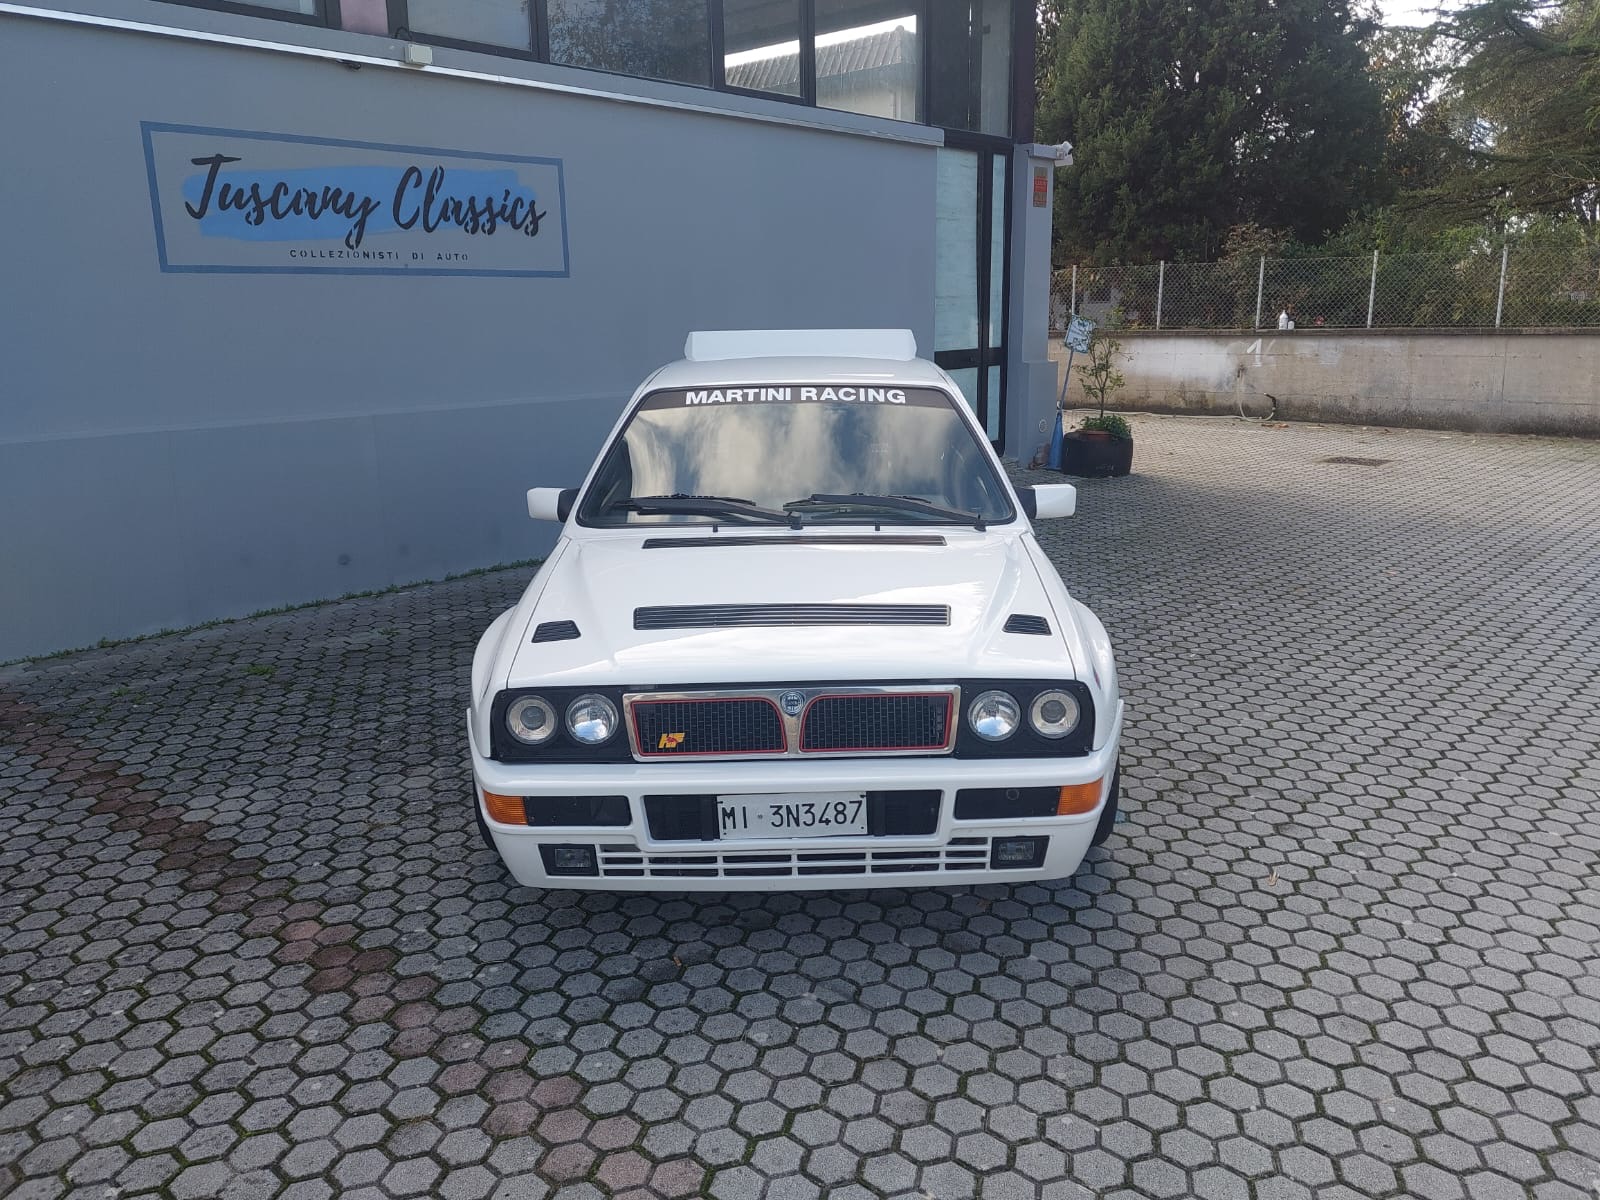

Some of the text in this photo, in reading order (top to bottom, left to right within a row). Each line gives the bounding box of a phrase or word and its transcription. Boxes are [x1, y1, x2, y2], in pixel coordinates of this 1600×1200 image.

[185, 154, 547, 250] Tuscany Classics
[289, 249, 469, 261] COLLEZIONISTI DI AUTO
[685, 387, 906, 405] MARTINI RACING
[721, 800, 863, 830] MI 3N3487
